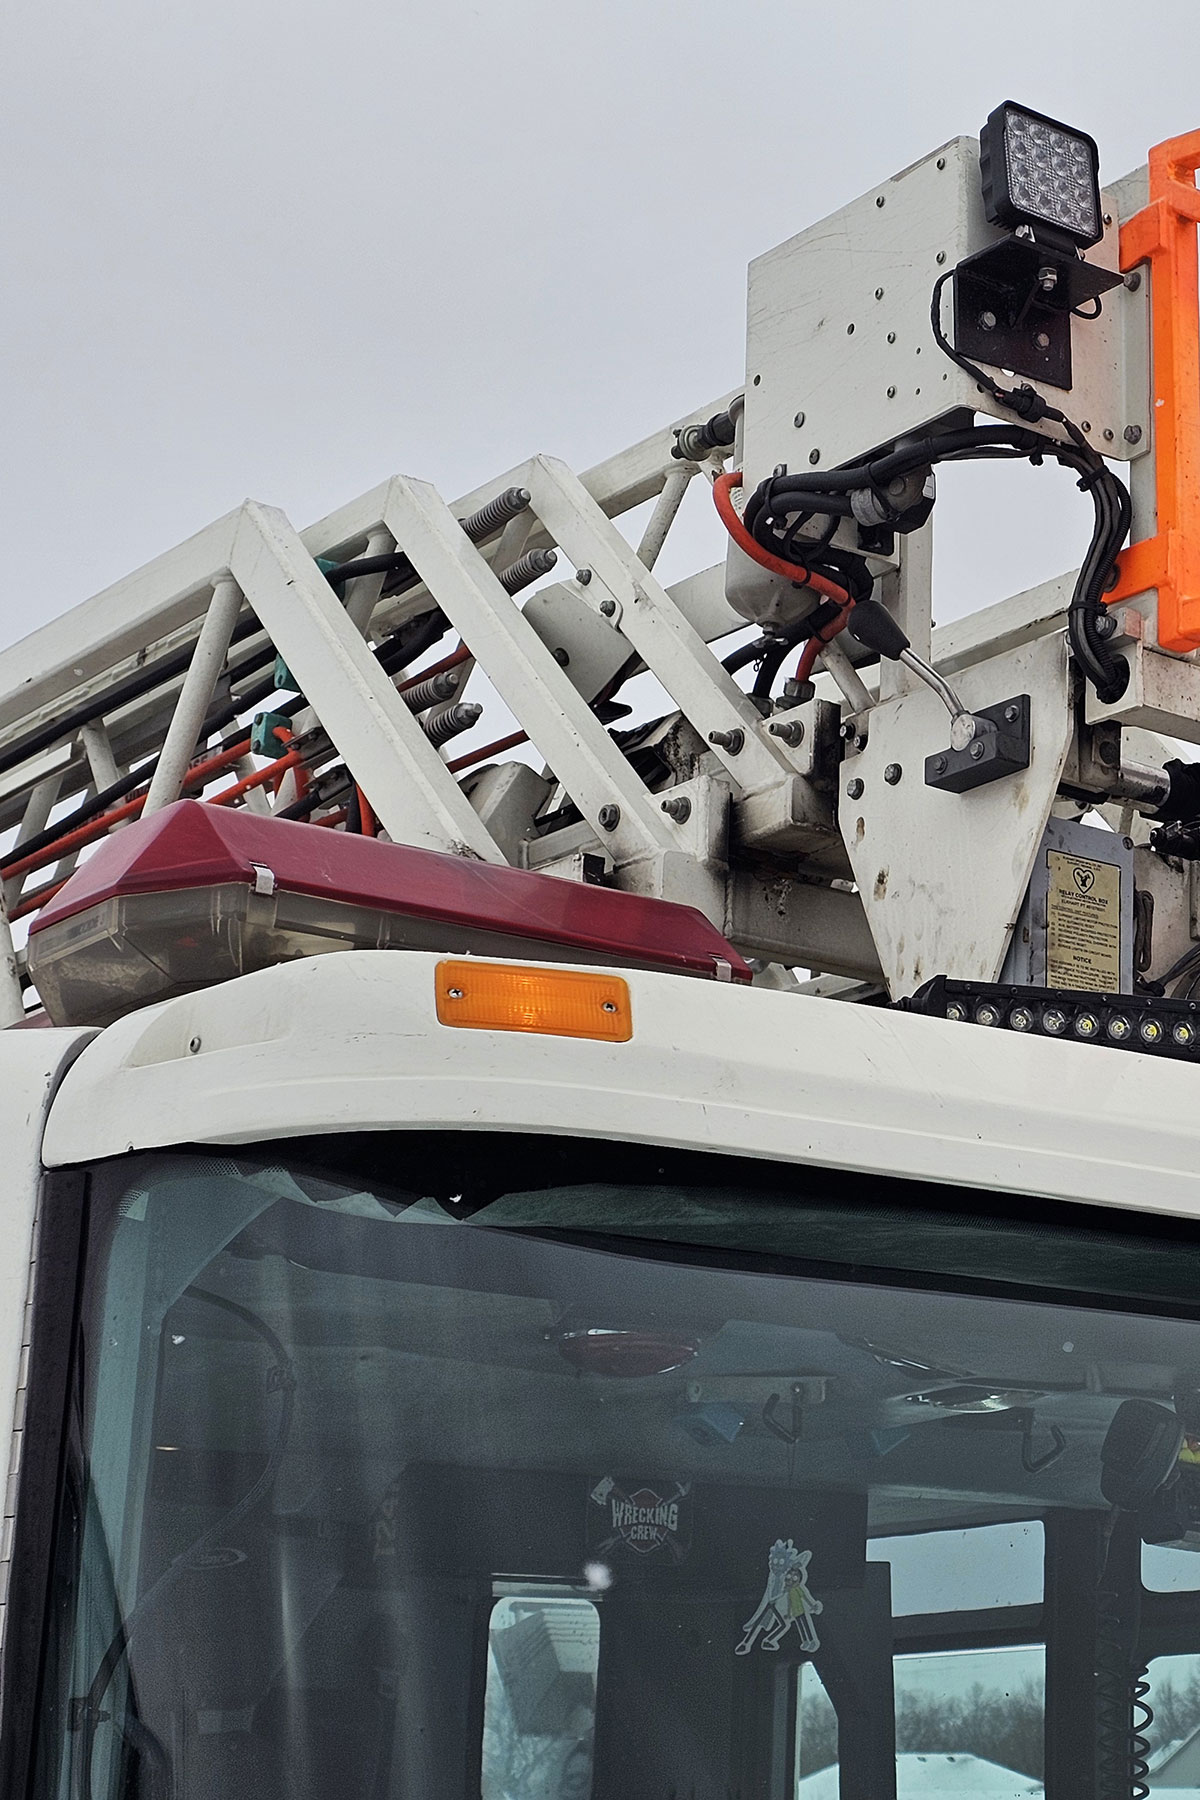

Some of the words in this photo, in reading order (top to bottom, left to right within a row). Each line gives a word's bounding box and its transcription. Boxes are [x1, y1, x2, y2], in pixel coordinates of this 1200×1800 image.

[1076, 892, 1097, 902] CONTROL
[1073, 955, 1092, 964] NOTICE
[611, 1499, 678, 1531] WRECKING
[631, 1525, 658, 1541] CREW
